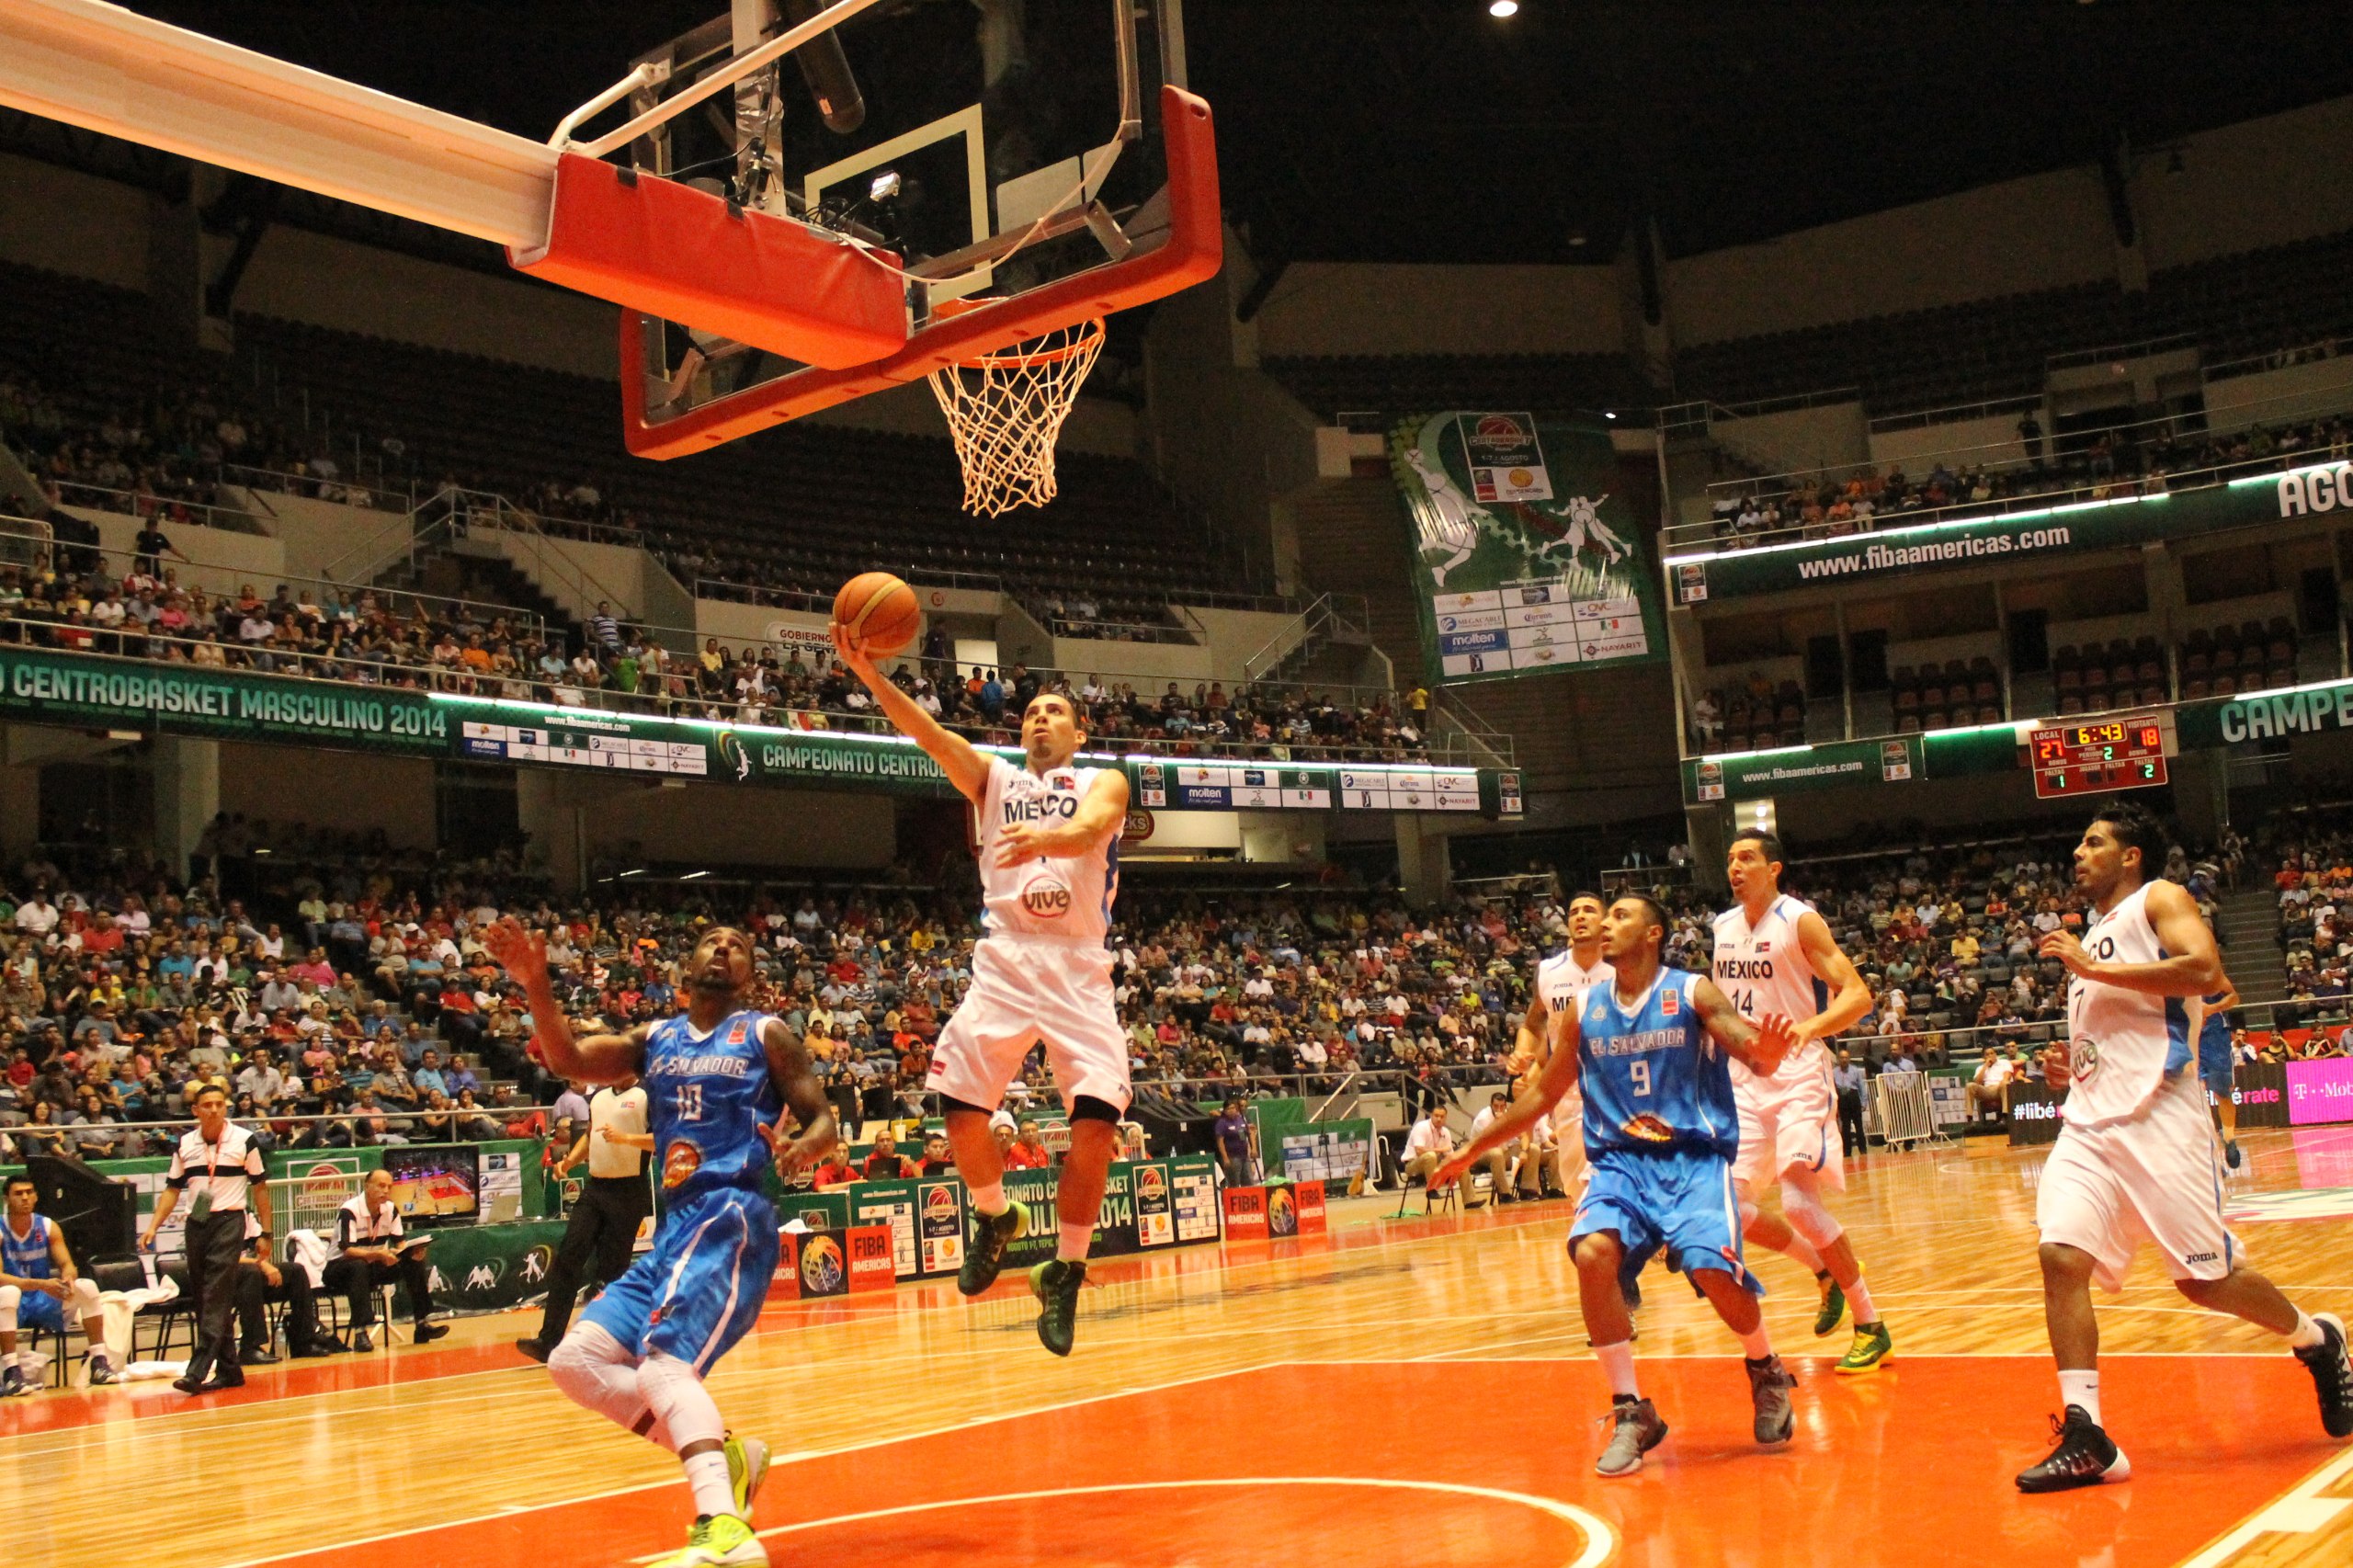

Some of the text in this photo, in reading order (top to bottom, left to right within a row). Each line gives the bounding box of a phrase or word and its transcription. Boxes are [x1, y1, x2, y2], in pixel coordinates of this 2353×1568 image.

[1799, 527, 2070, 579] www.fibaamericas.com
[1452, 633, 1495, 646] molten
[1601, 642, 1642, 653] NAYARIT
[14, 664, 233, 716] CENTROBASKET
[241, 689, 384, 732] MASCULINO
[390, 705, 448, 738] 2014
[544, 715, 631, 733] www.fibaamericas.com
[2127, 718, 2159, 729] VISITANTE
[2034, 730, 2060, 741] LOCAL
[2078, 723, 2124, 744] 6:43
[2141, 728, 2160, 748] 18
[763, 744, 874, 774] CAMPEONATO
[2040, 740, 2063, 759] 27
[2103, 745, 2114, 761] 2
[1743, 761, 1863, 782] www.fibaamericas.com
[2144, 764, 2155, 779] 2
[2059, 774, 2066, 789] 1
[1188, 788, 1222, 799] molten
[1716, 957, 1773, 980] MÉXICO
[1732, 988, 1754, 1016] 14
[2075, 987, 2086, 1023] 7
[1589, 1027, 1686, 1058] EL SALVADOR
[1630, 1059, 1651, 1097] 9
[676, 1083, 702, 1122] 10
[1230, 1195, 1259, 1212] FIBA
[1300, 1187, 1321, 1206] FIBA
[1227, 1212, 1265, 1225] AMERICAS
[854, 1234, 886, 1258] FIBA
[852, 1256, 892, 1273] AMERICAS
